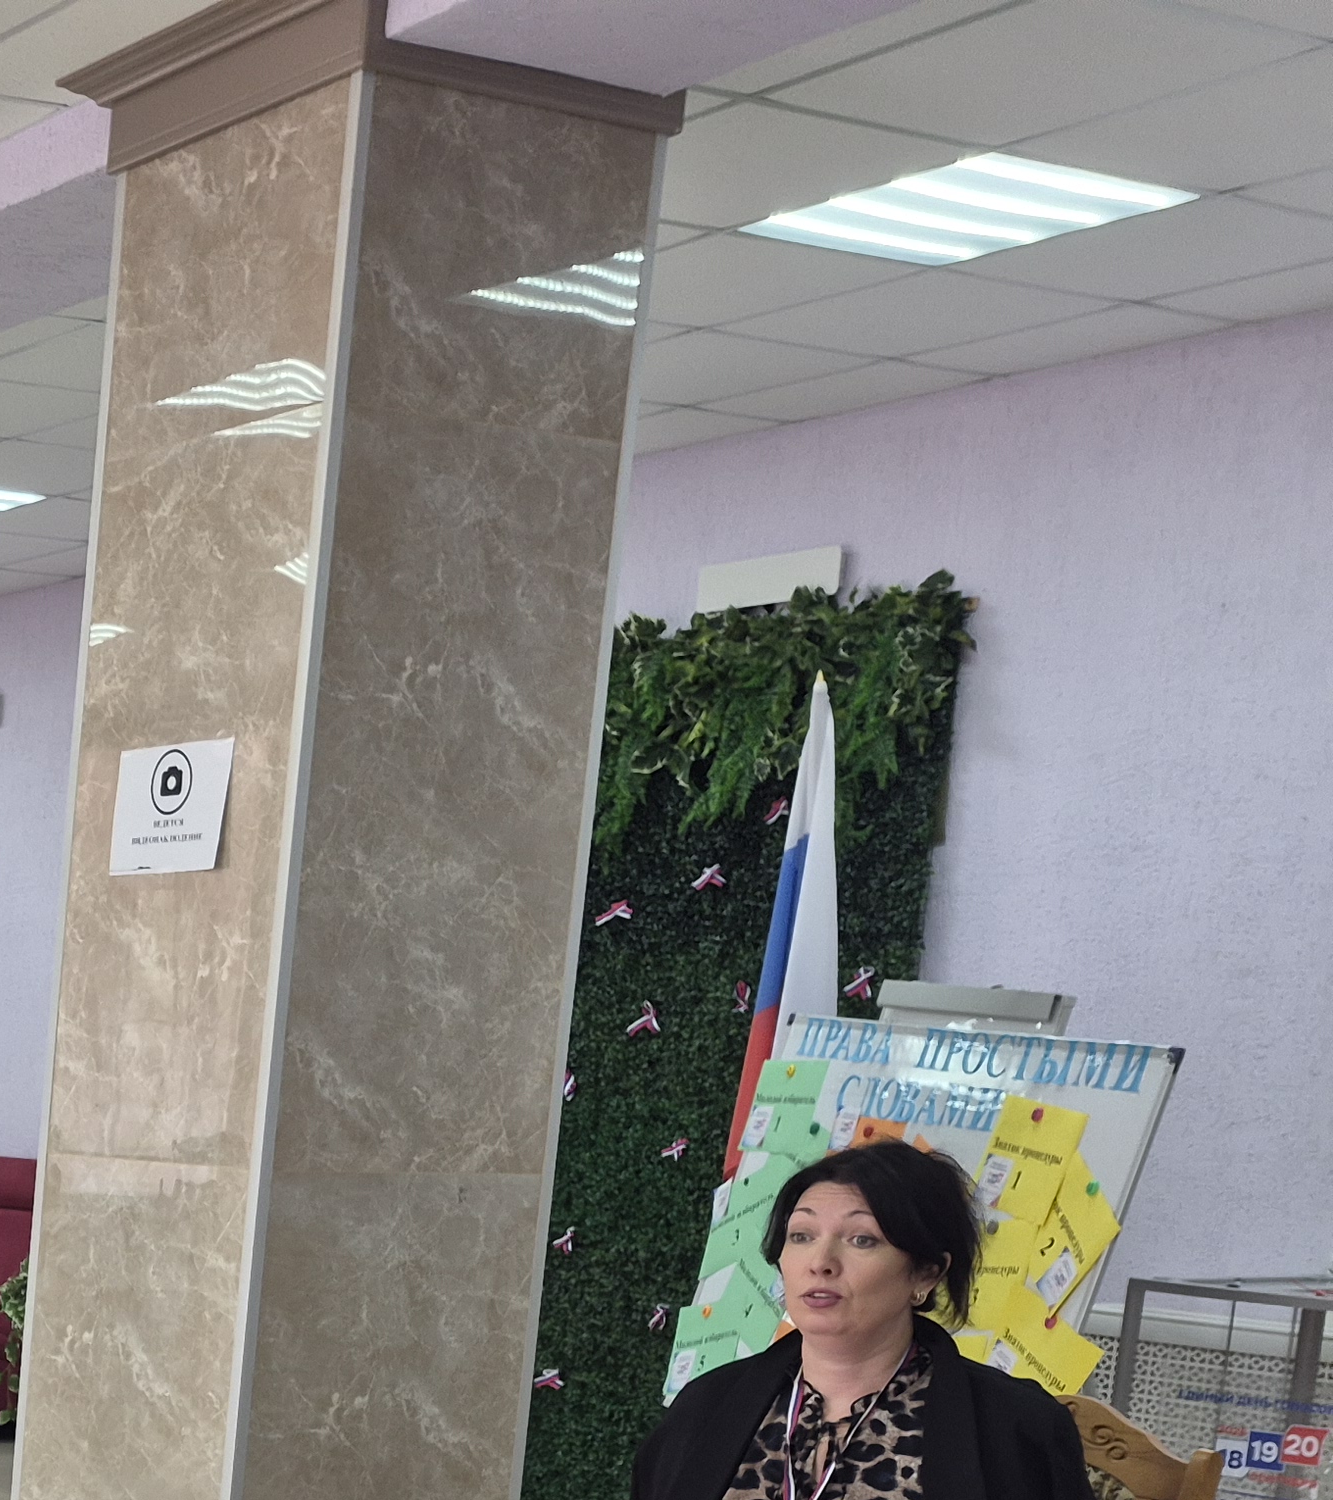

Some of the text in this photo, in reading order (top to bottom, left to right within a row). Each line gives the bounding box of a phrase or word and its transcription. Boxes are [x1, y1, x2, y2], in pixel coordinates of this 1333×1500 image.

[796, 1017, 1153, 1094] ПРАВА ПРОСТЫМИ
[836, 1074, 1006, 1132] СЛОВАМИ
[1010, 1170, 1022, 1190] 1
[1039, 1237, 1055, 1257] 2
[1250, 1440, 1279, 1463] 19
[1284, 1434, 1320, 1458] 20
